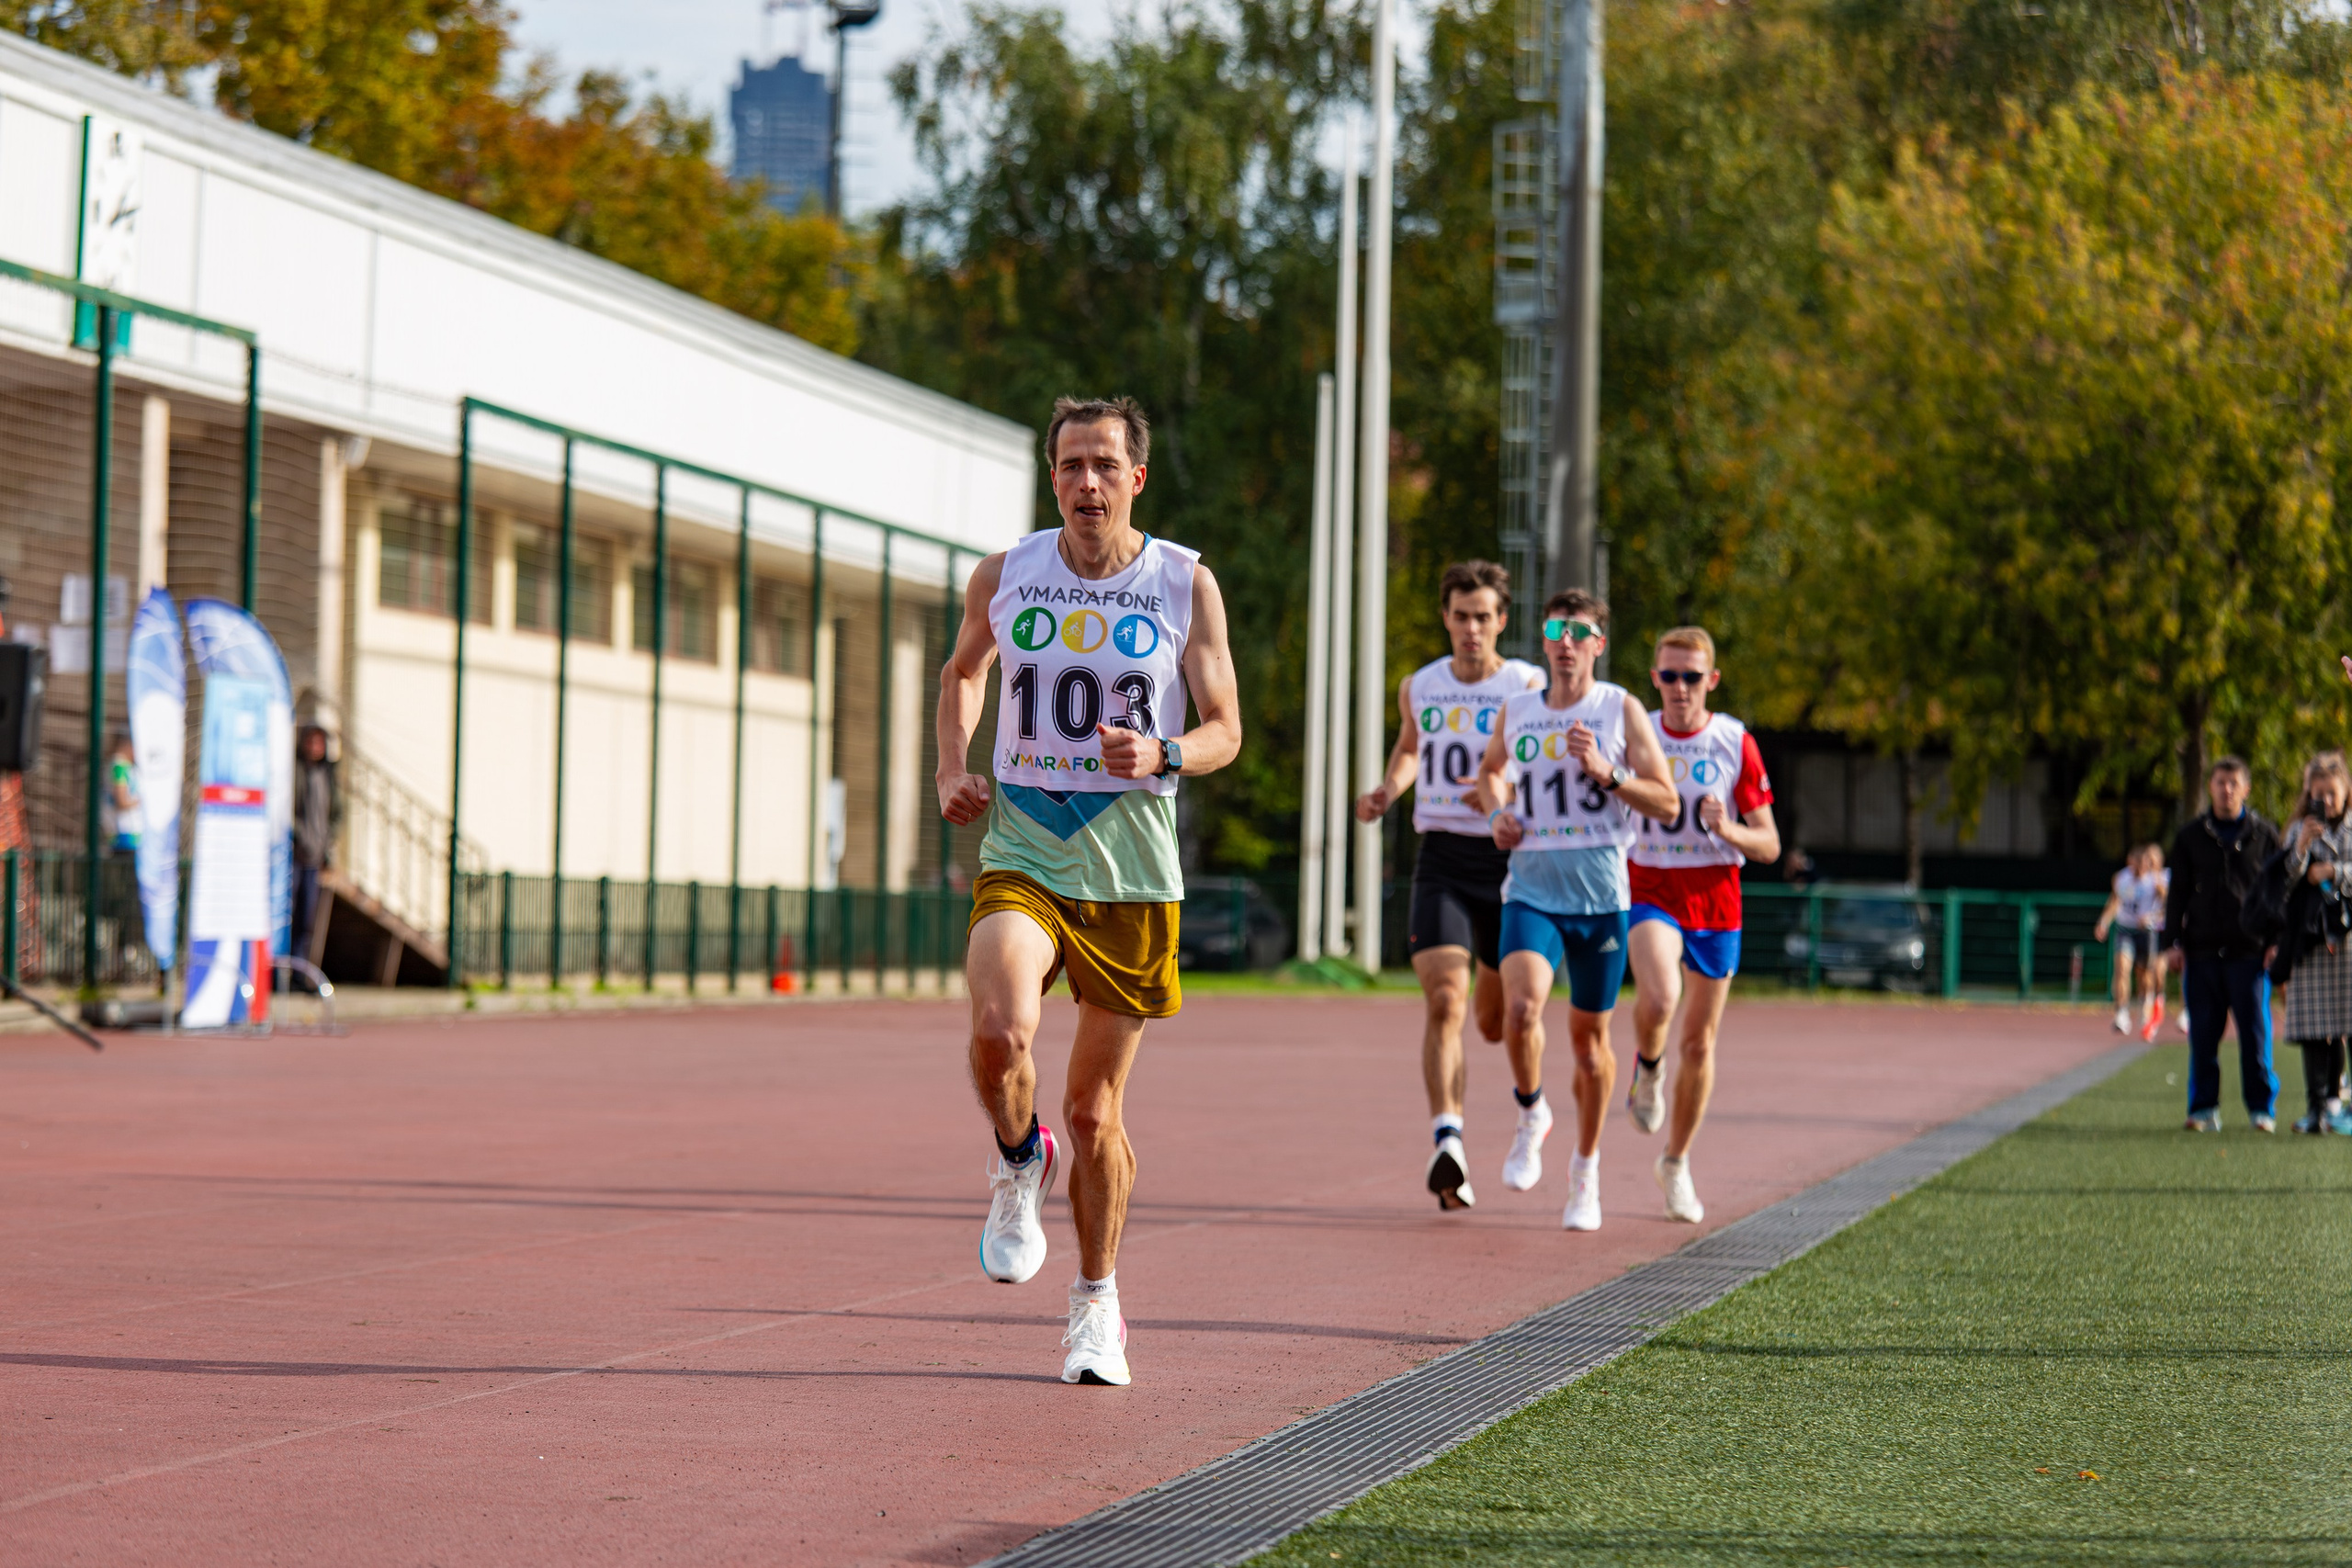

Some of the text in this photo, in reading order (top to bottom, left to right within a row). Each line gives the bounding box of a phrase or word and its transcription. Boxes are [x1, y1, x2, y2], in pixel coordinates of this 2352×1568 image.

[1018, 585, 1163, 614] VMARAFONE
[1010, 663, 1156, 742] 103
[1010, 752, 1107, 773] VMARAFO
[1422, 741, 1486, 788] 10
[1519, 769, 1608, 819] 113
[1524, 826, 1591, 837] MARAFONE
